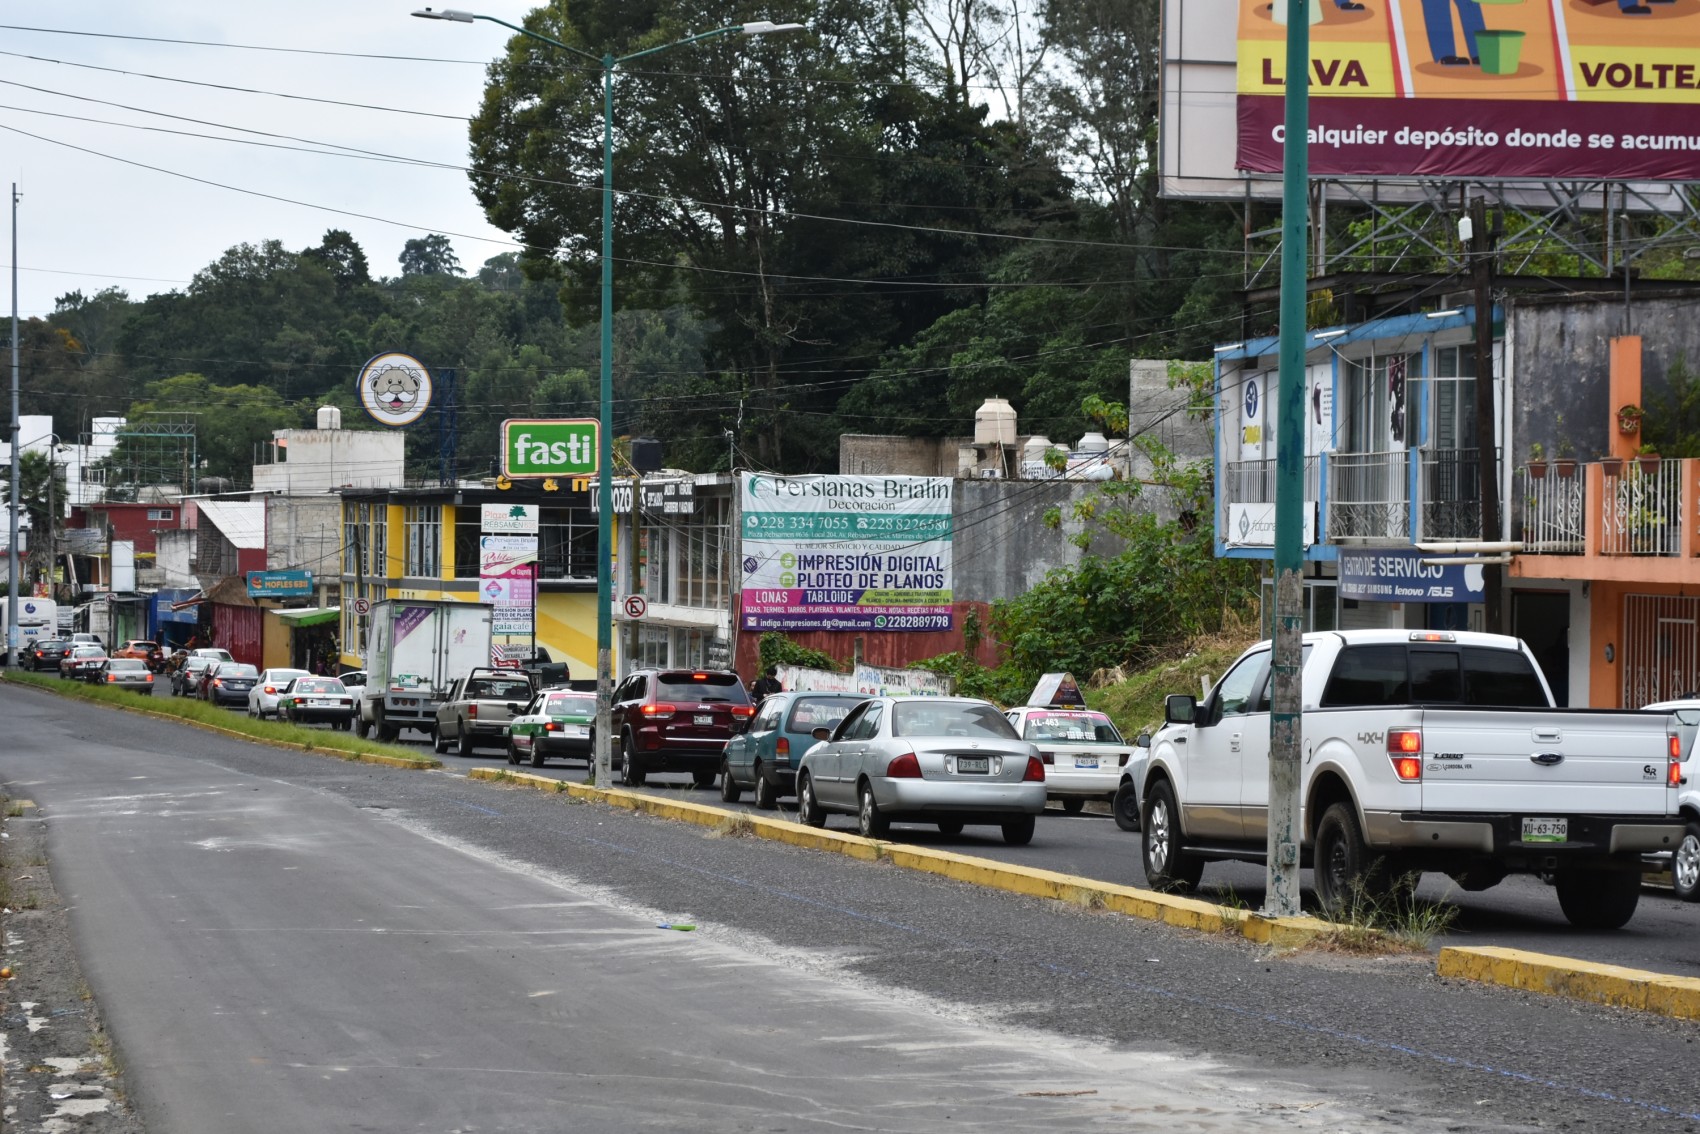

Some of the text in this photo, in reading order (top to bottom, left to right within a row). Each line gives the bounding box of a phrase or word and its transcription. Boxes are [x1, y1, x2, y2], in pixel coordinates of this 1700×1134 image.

[1262, 58, 1369, 87] LVA
[1579, 62, 1700, 89] VOLTE
[1271, 124, 1388, 148] Calquier
[1394, 126, 1499, 149] depósito
[1505, 128, 1582, 148] donde
[1588, 132, 1615, 148] se
[514, 433, 591, 465] fasti
[774, 478, 949, 499] Persianas Brialin
[828, 499, 896, 511] Decoración
[484, 511, 508, 519] Plaza
[760, 517, 785, 529] 228
[789, 517, 814, 529] 334
[818, 517, 849, 530] 7055
[869, 518, 893, 530] 228
[868, 543, 900, 551] CALIDAD
[798, 552, 944, 572] IMPRESIÓN DIGITAL
[1344, 556, 1364, 576] CENTRO
[1364, 556, 1377, 576] DE
[797, 573, 944, 589] PLOTEO DE PLANOS
[755, 591, 788, 603] LONAS
[807, 590, 854, 603] TABLOIDE
[1367, 584, 1392, 594] SAMSUNG
[1395, 585, 1424, 596] lenovo
[1427, 586, 1454, 597] ASUS
[494, 622, 530, 631] gaia café
[760, 616, 949, 628] indigo.impresiones.dg@gmail.com 2282889798
[1031, 719, 1060, 727] XL-463
[959, 760, 987, 769] 739-RLG
[1523, 823, 1566, 834] XU-63-750
